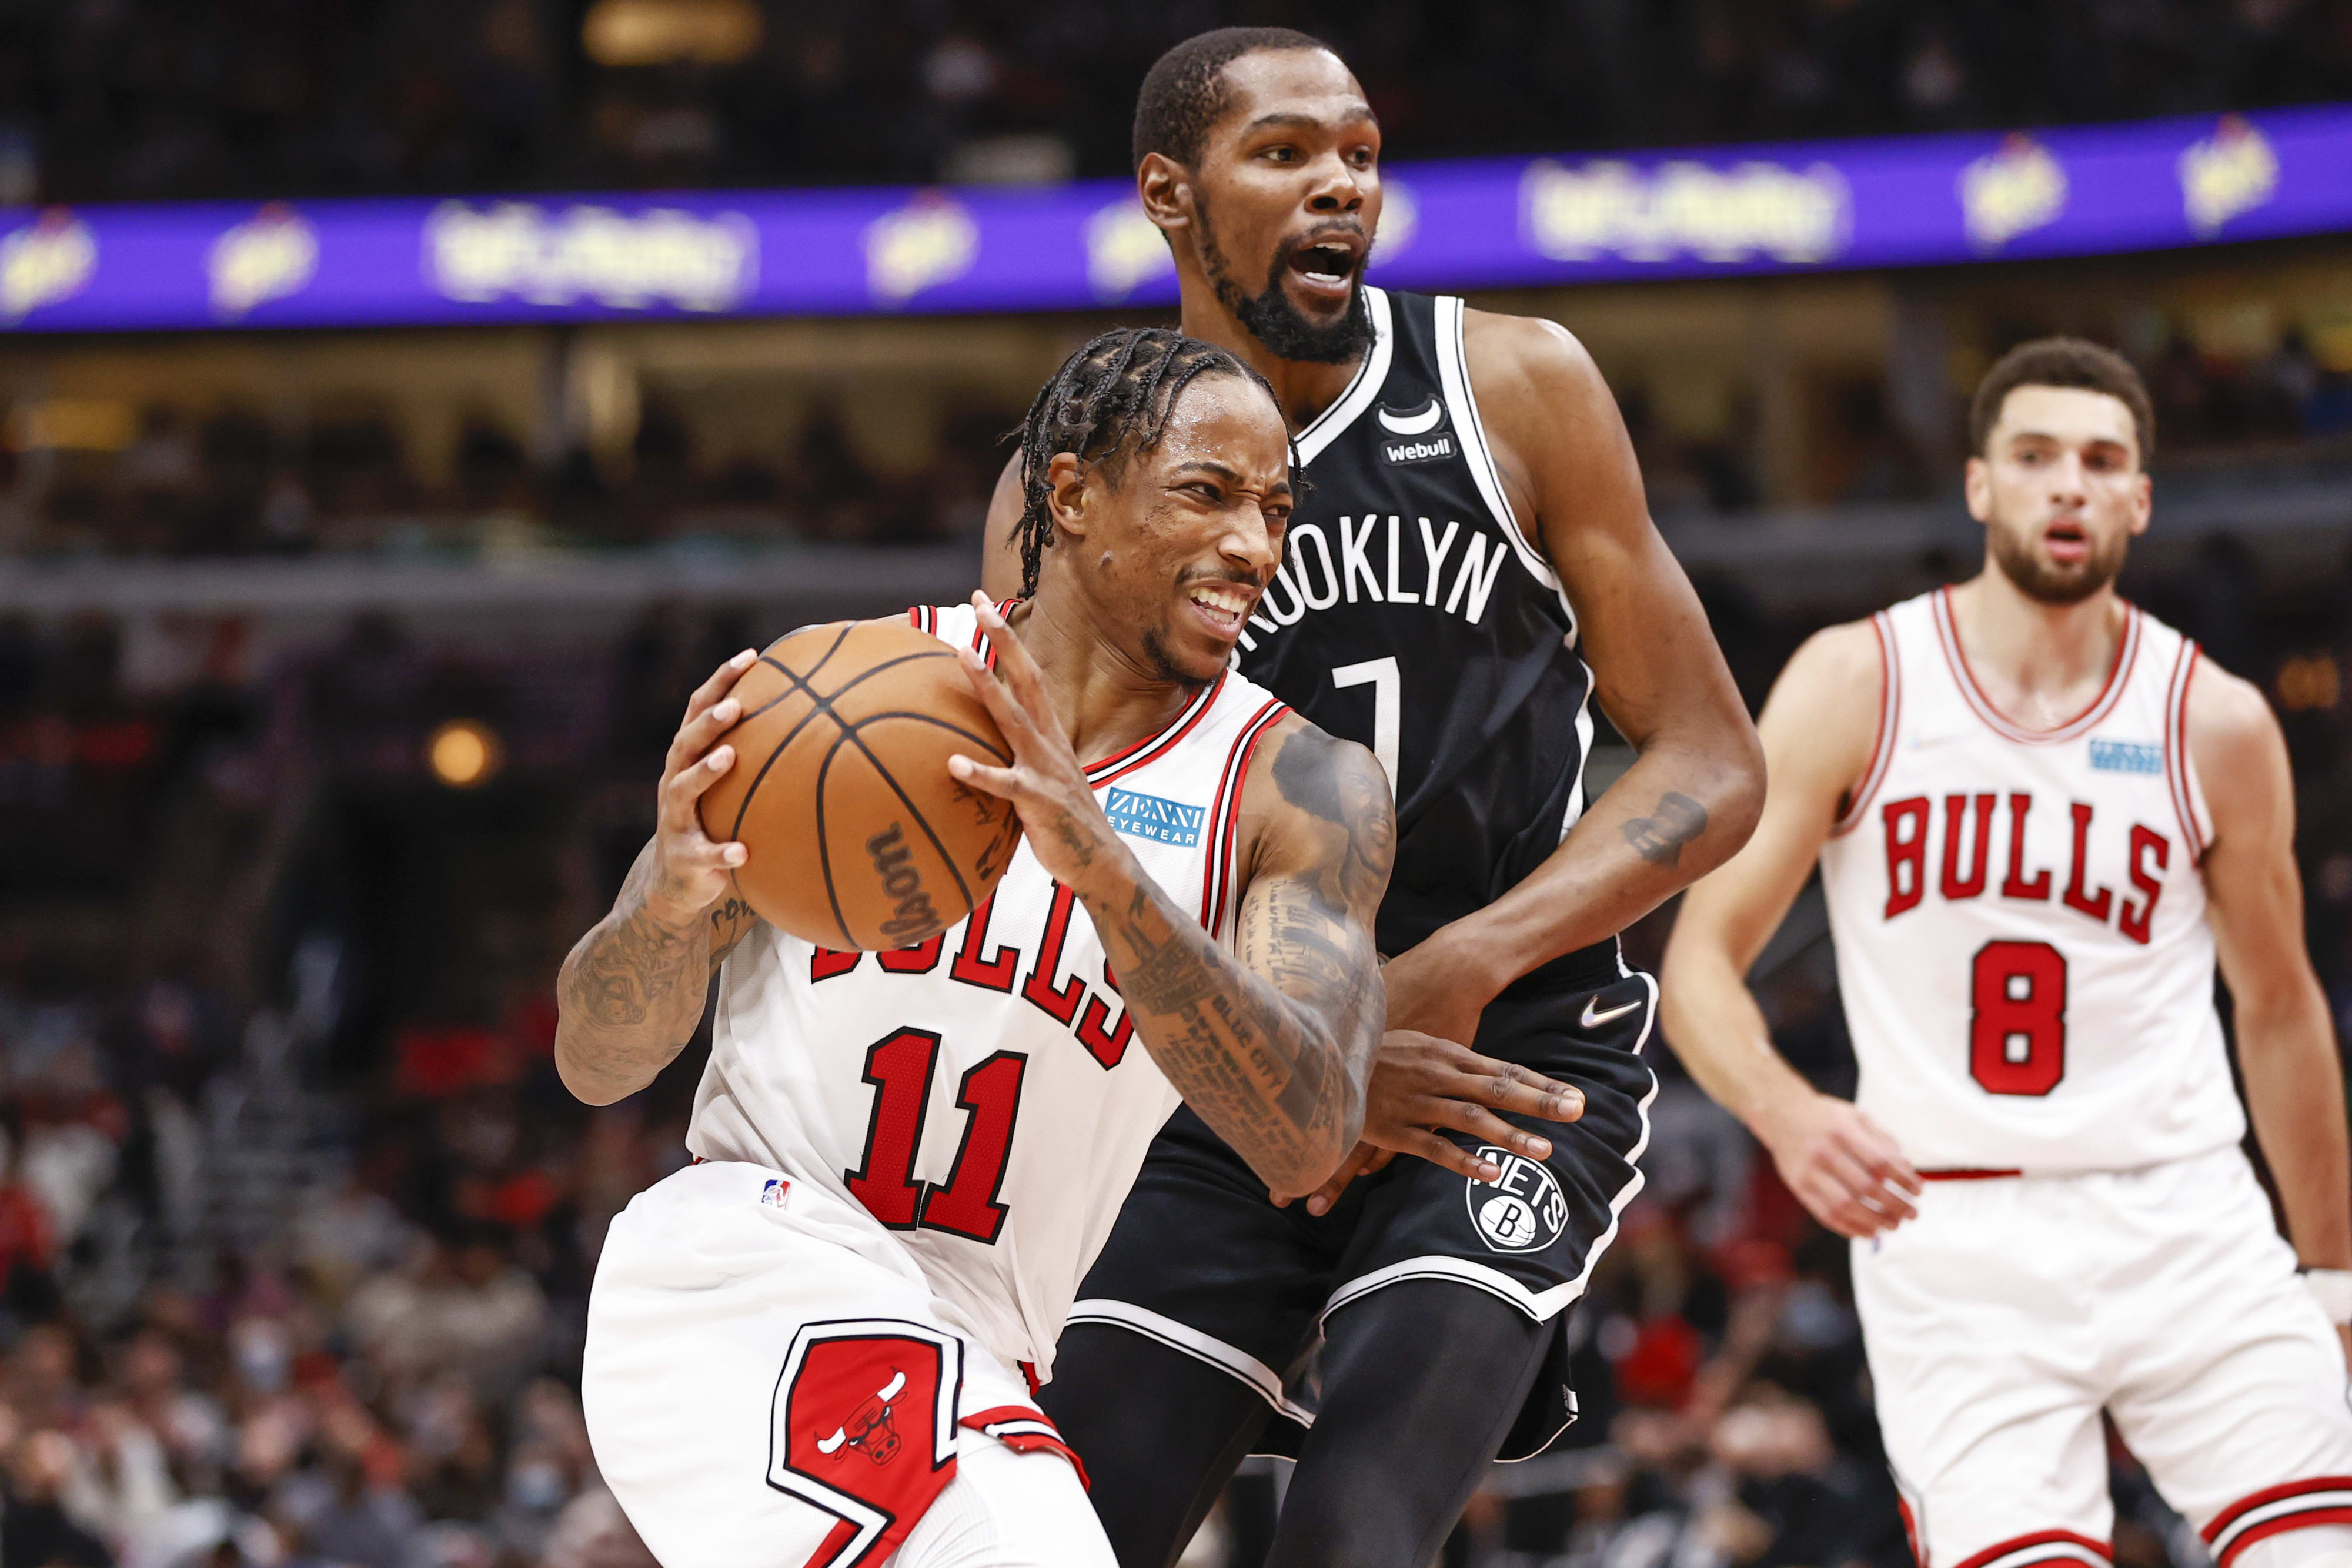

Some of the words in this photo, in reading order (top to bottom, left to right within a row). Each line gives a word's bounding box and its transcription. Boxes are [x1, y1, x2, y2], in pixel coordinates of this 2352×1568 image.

[1387, 438, 1450, 462] Webull
[1230, 514, 1508, 671] OOKLYN
[1332, 656, 1401, 807] 7
[1107, 815, 1195, 844] EYEWEAR
[1110, 792, 1201, 828] ZENNI
[1882, 794, 2169, 945] BULLS
[1970, 940, 2067, 1096] 8
[844, 1025, 1028, 1245] 11
[1472, 1151, 1564, 1234] NETS
[1495, 1203, 1522, 1238] B
